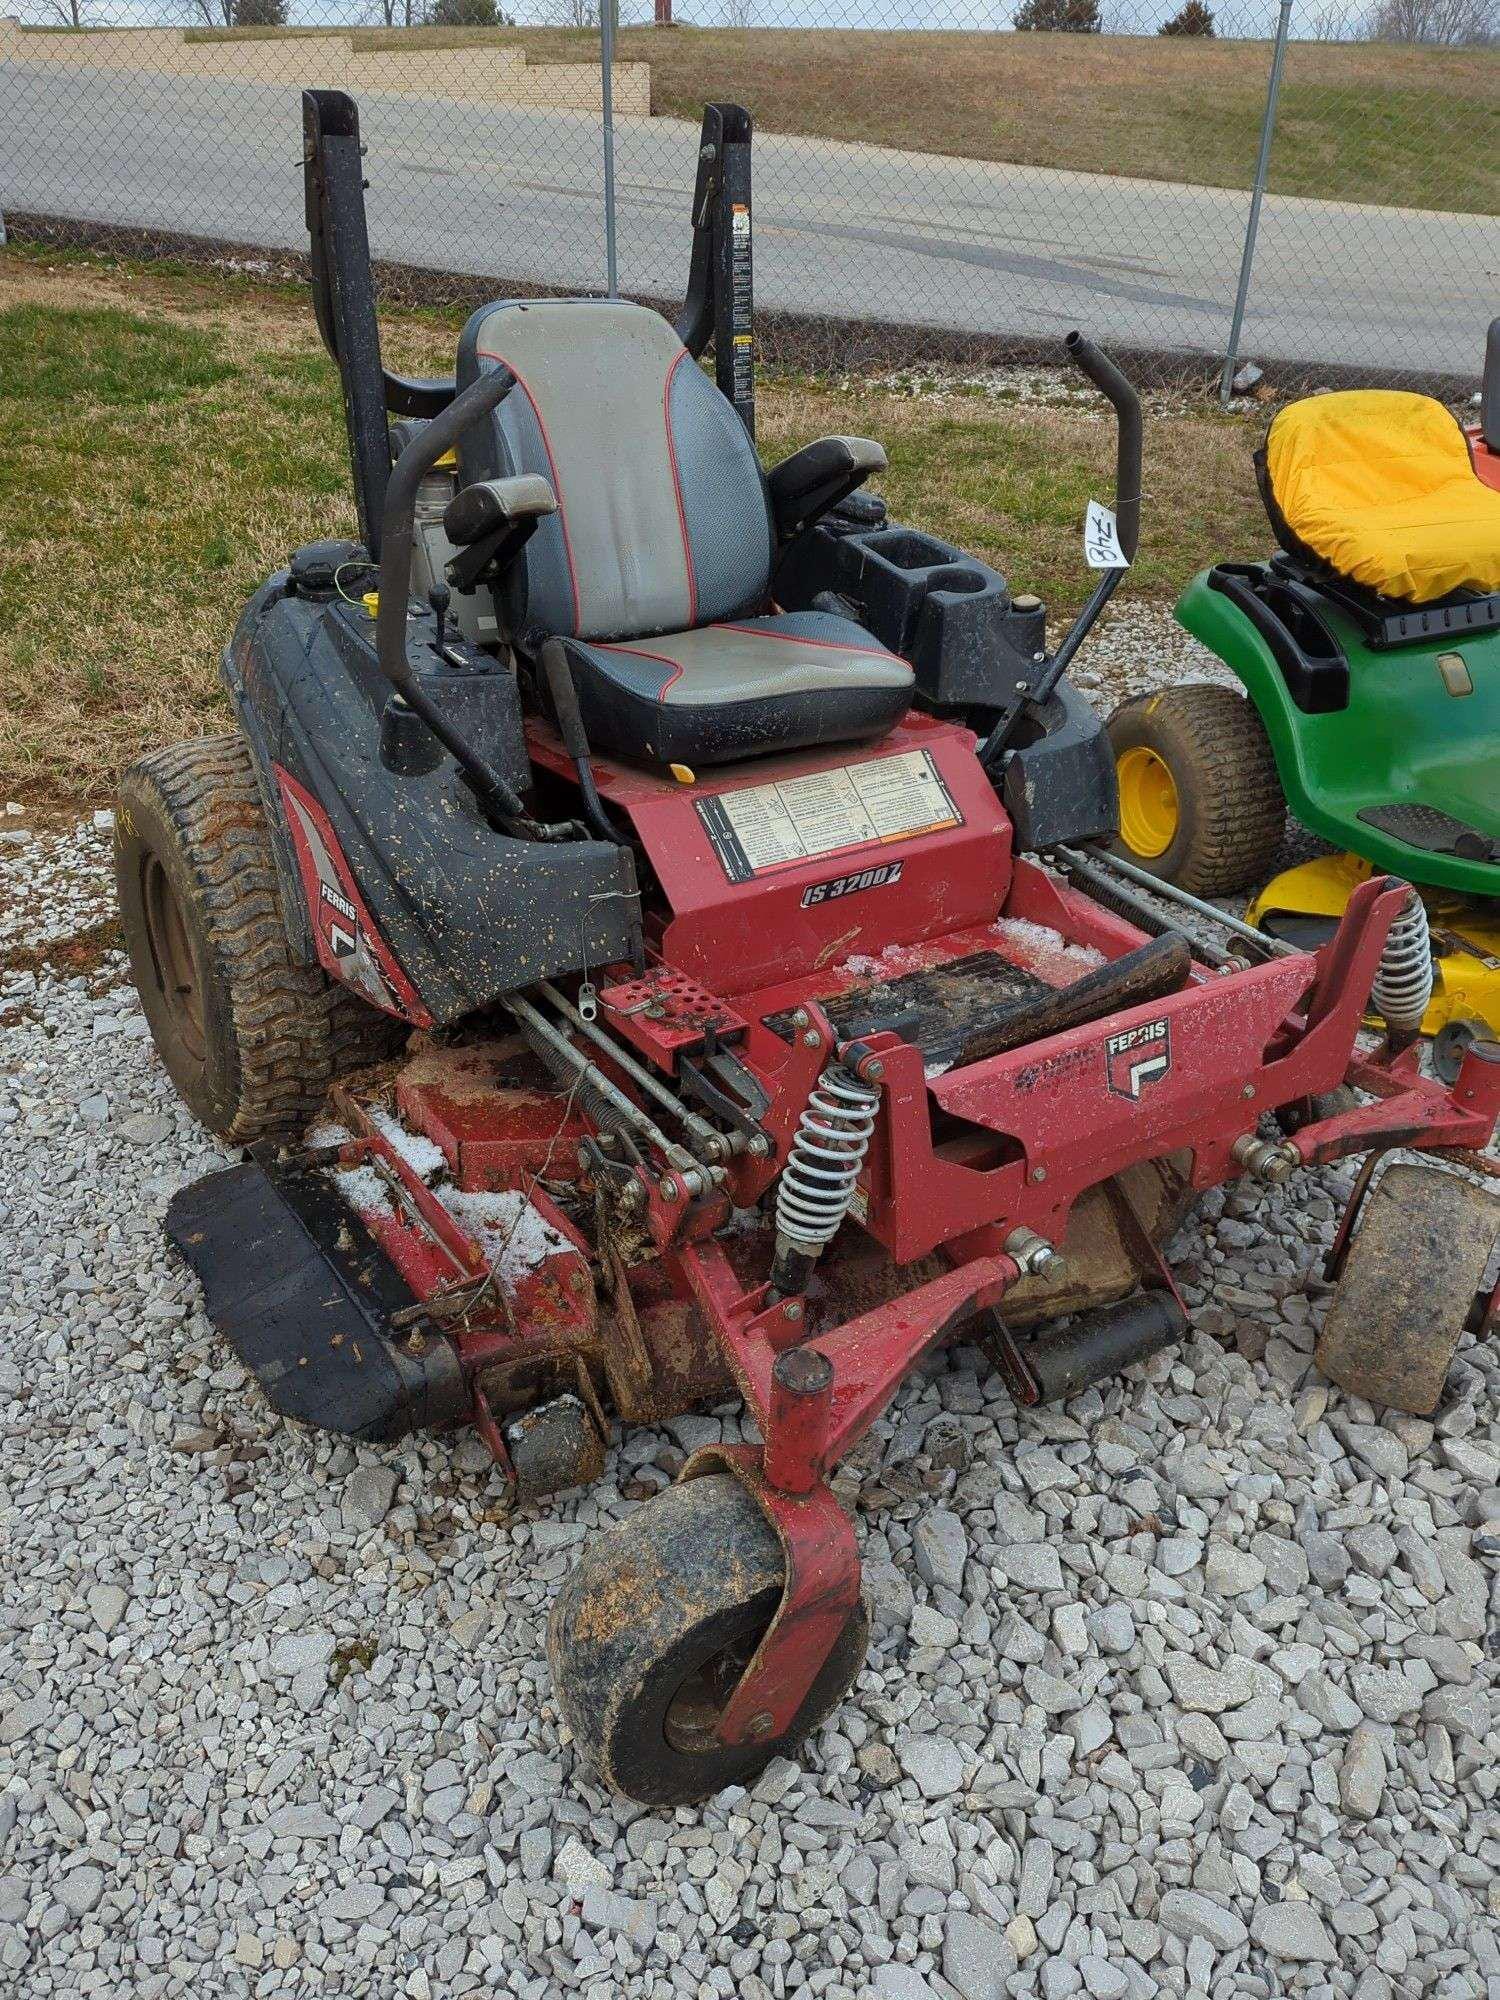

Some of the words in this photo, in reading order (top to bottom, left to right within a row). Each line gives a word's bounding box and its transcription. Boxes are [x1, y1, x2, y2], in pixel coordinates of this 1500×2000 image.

[1086, 515, 1118, 563] 748
[321, 882, 357, 921] FERRIS
[803, 884, 828, 906] IS
[829, 862, 903, 898] 3200Z
